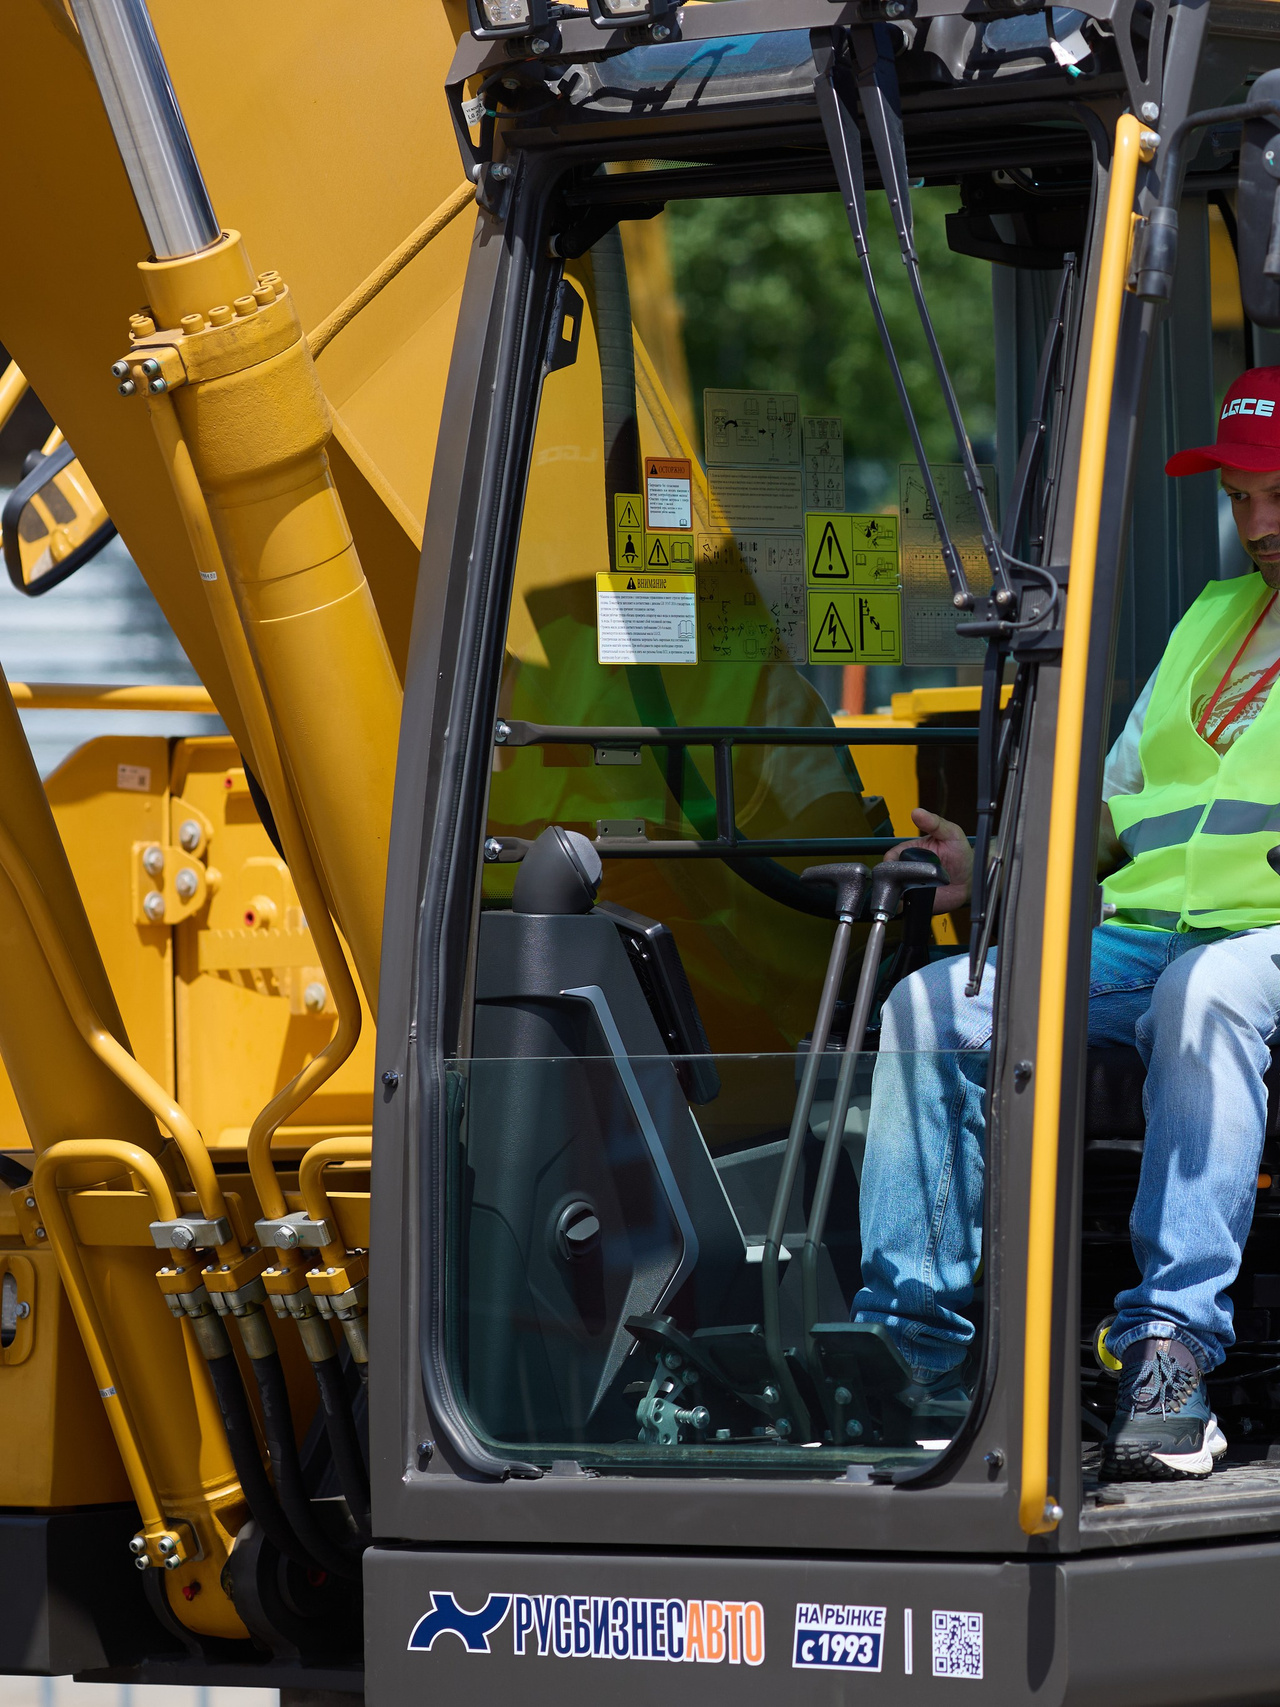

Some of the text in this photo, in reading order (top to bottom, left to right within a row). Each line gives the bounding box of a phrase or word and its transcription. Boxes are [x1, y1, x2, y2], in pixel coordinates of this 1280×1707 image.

[1221, 398, 1275, 420] LGCE
[798, 1606, 884, 1627] НА РЫНКЕ
[818, 1633, 874, 1664] 1993
